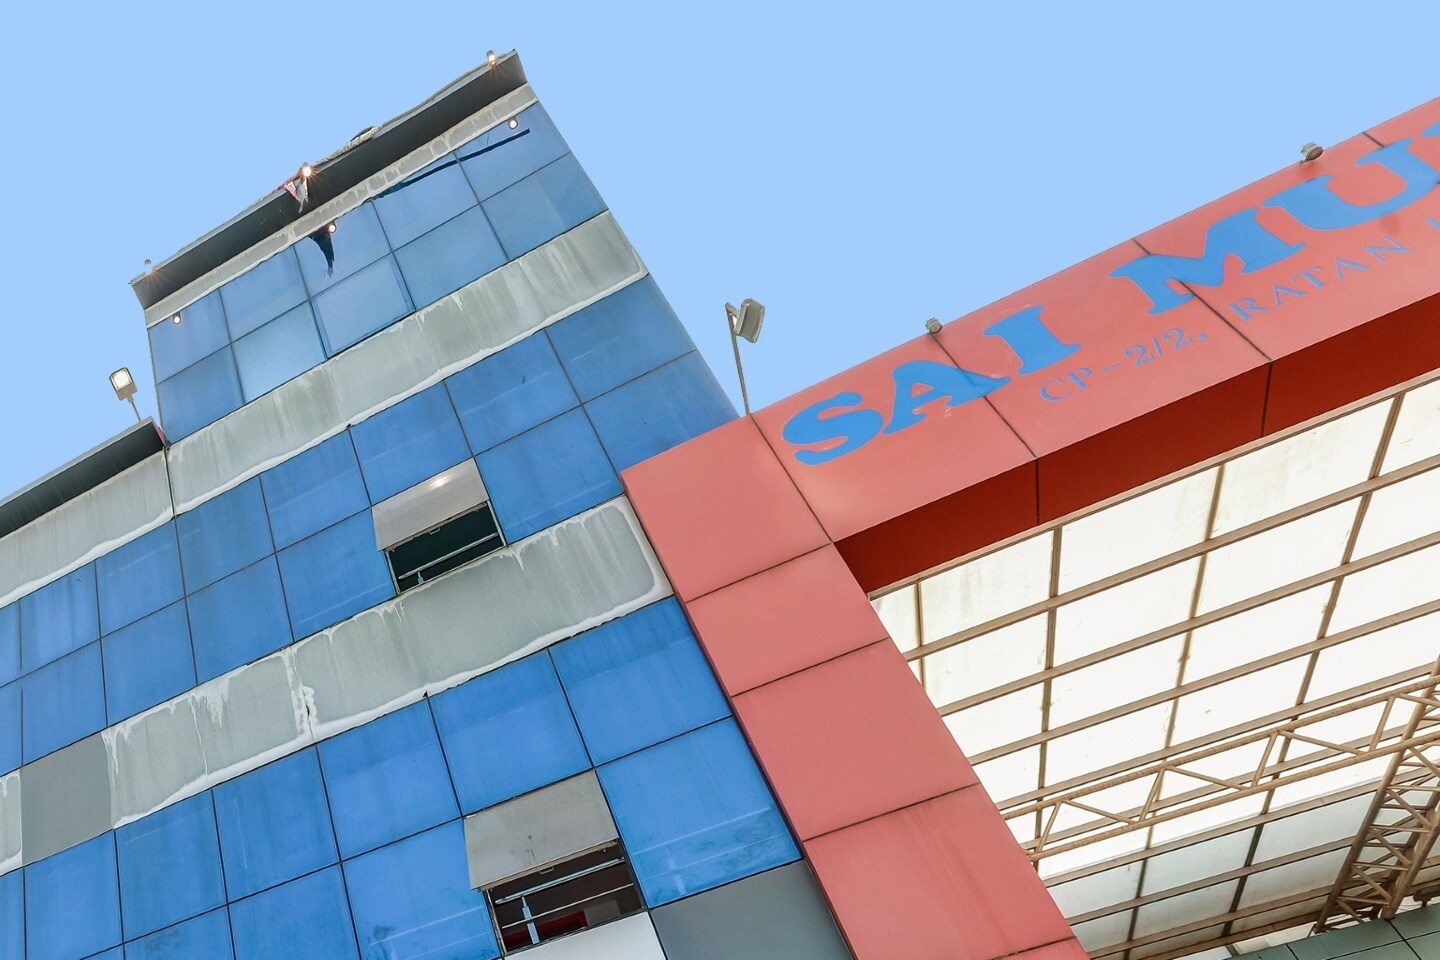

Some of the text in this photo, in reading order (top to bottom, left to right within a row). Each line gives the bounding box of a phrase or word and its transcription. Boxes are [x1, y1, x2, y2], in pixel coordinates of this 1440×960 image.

[781, 121, 1440, 465] SAI MU
[1228, 236, 1410, 321] RATAN
